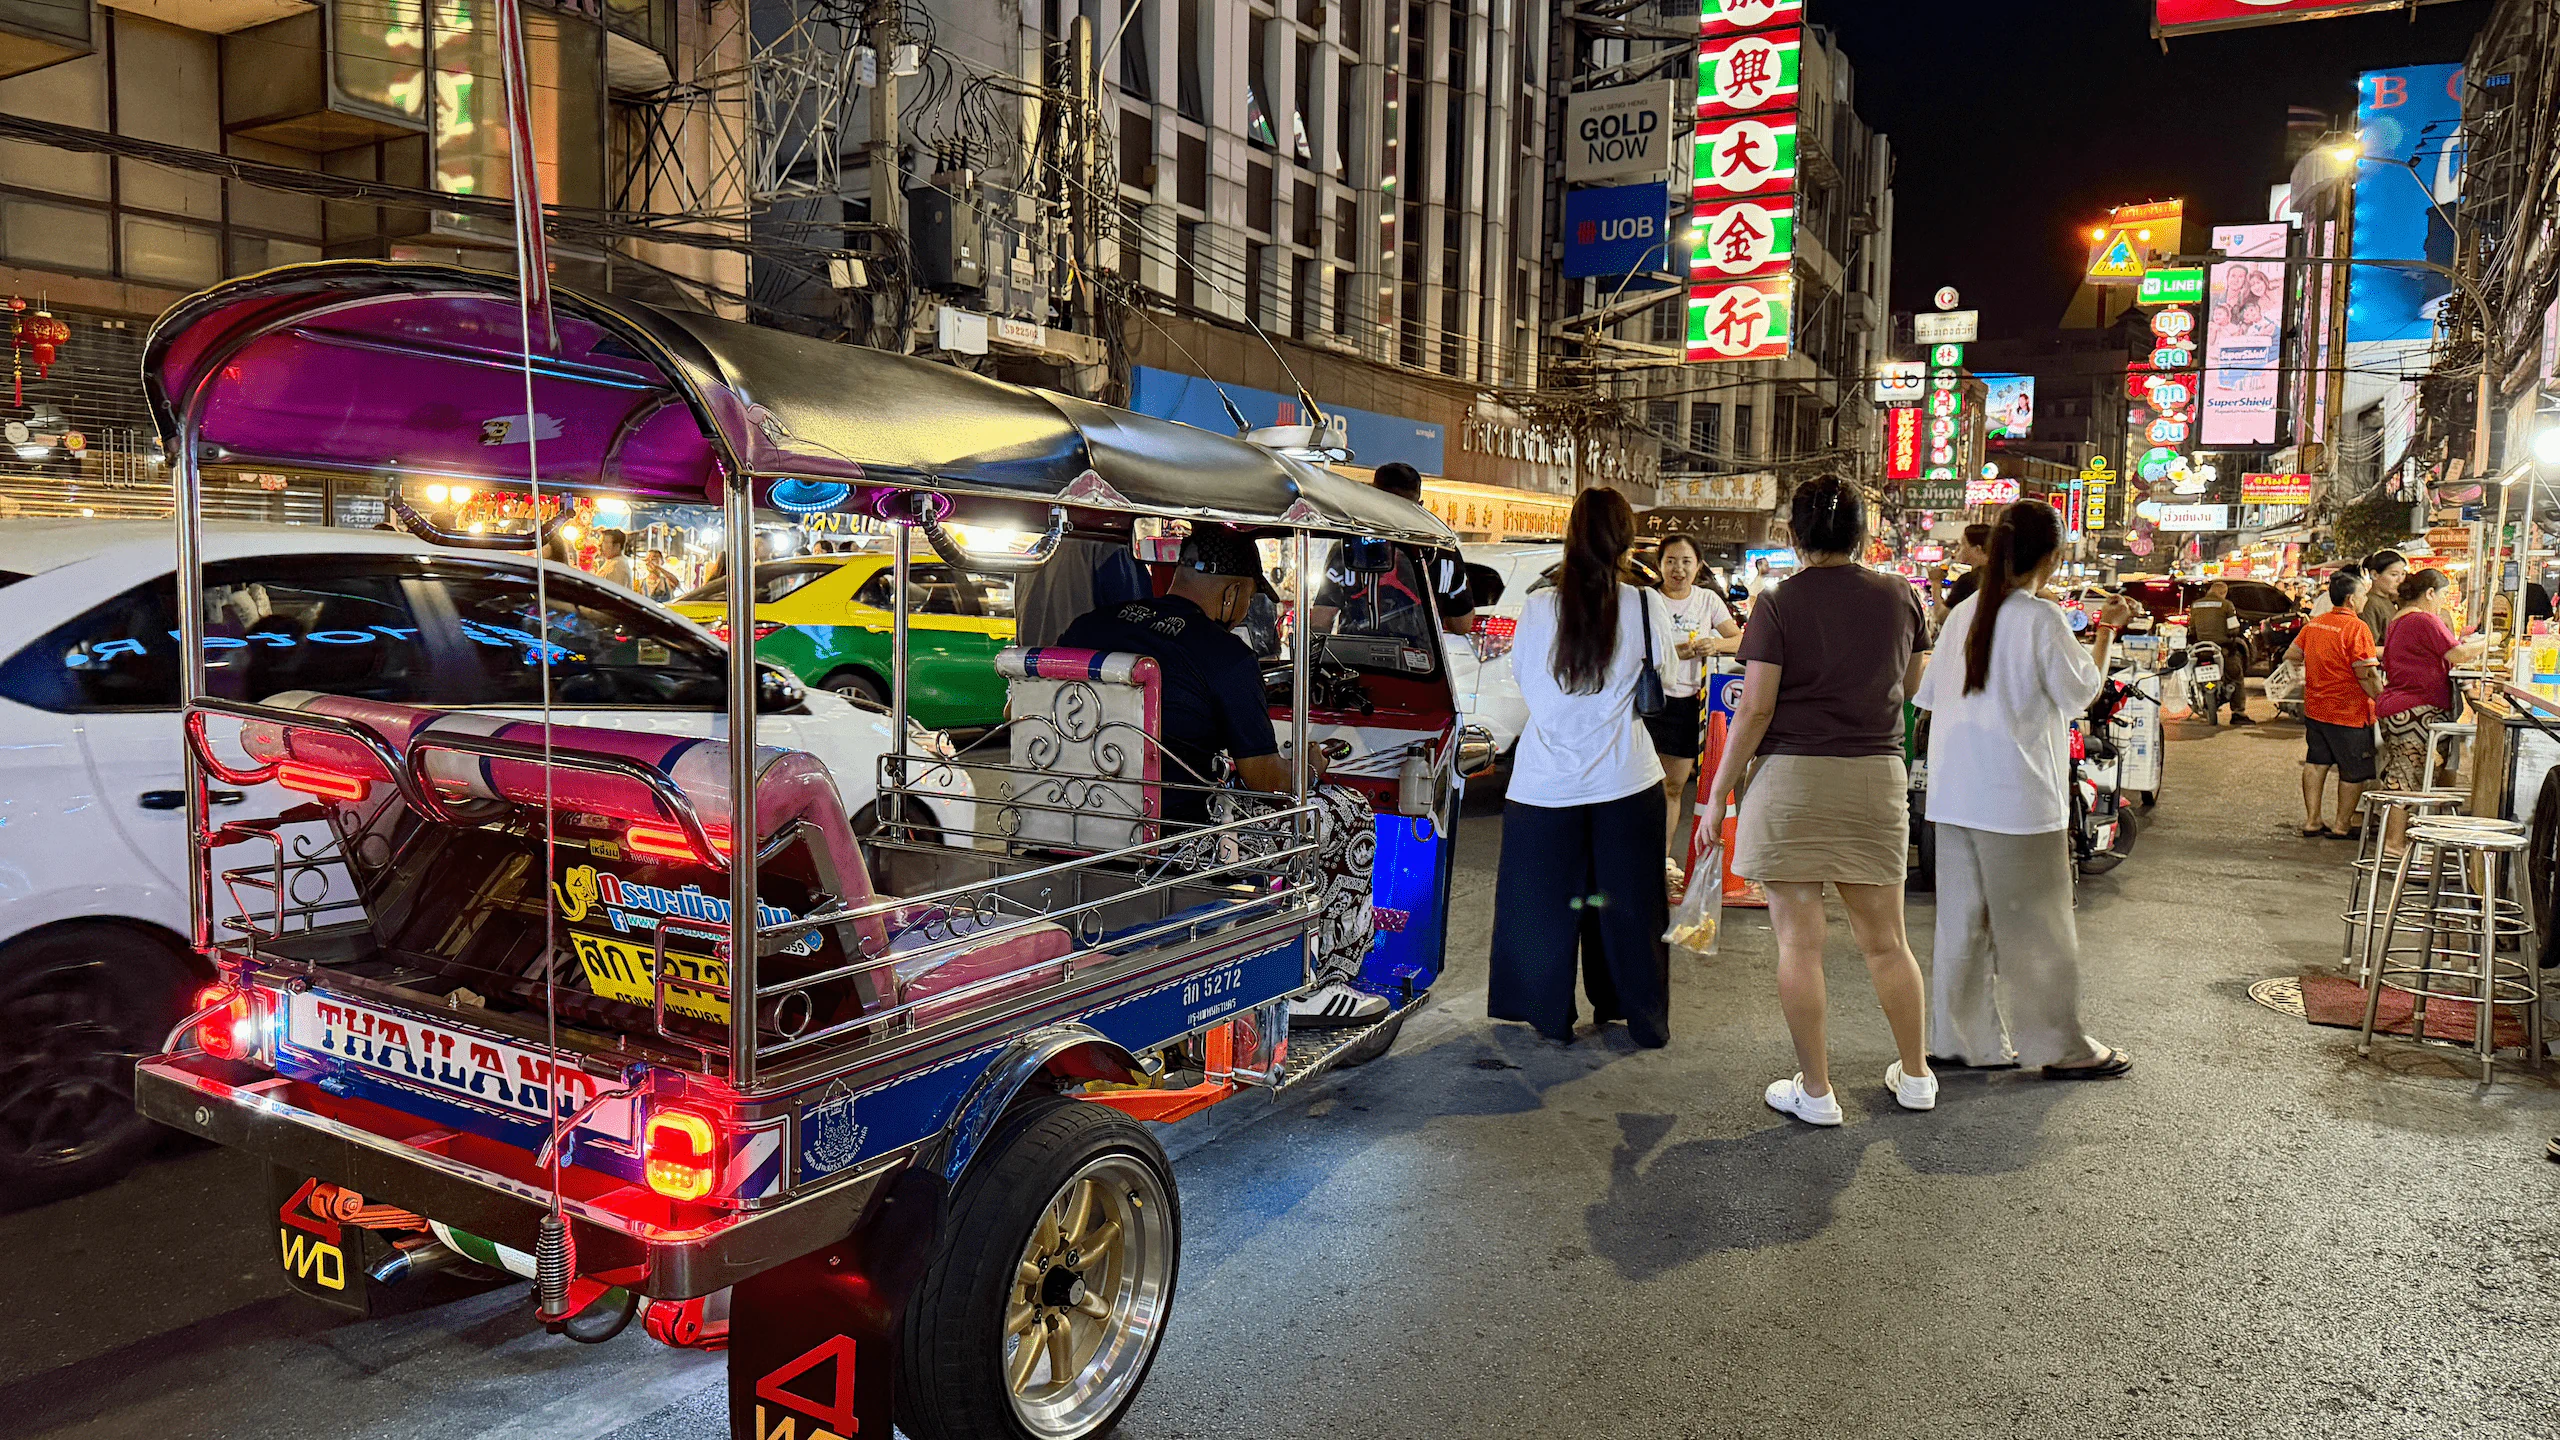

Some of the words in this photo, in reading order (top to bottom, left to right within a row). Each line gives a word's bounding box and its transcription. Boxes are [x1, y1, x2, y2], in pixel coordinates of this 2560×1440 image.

[1580, 110, 1657, 141] GOLD
[1588, 136, 1648, 164] NOW
[1710, 0, 1776, 348] 興大金行
[1601, 216, 1654, 241] UOB
[2163, 280, 2194, 292] LINE
[2206, 396, 2274, 408] SuperShield
[579, 940, 637, 985] สก
[1183, 982, 1199, 1006] สก
[1204, 968, 1242, 997] 5272
[316, 1000, 599, 1124] THAILAND
